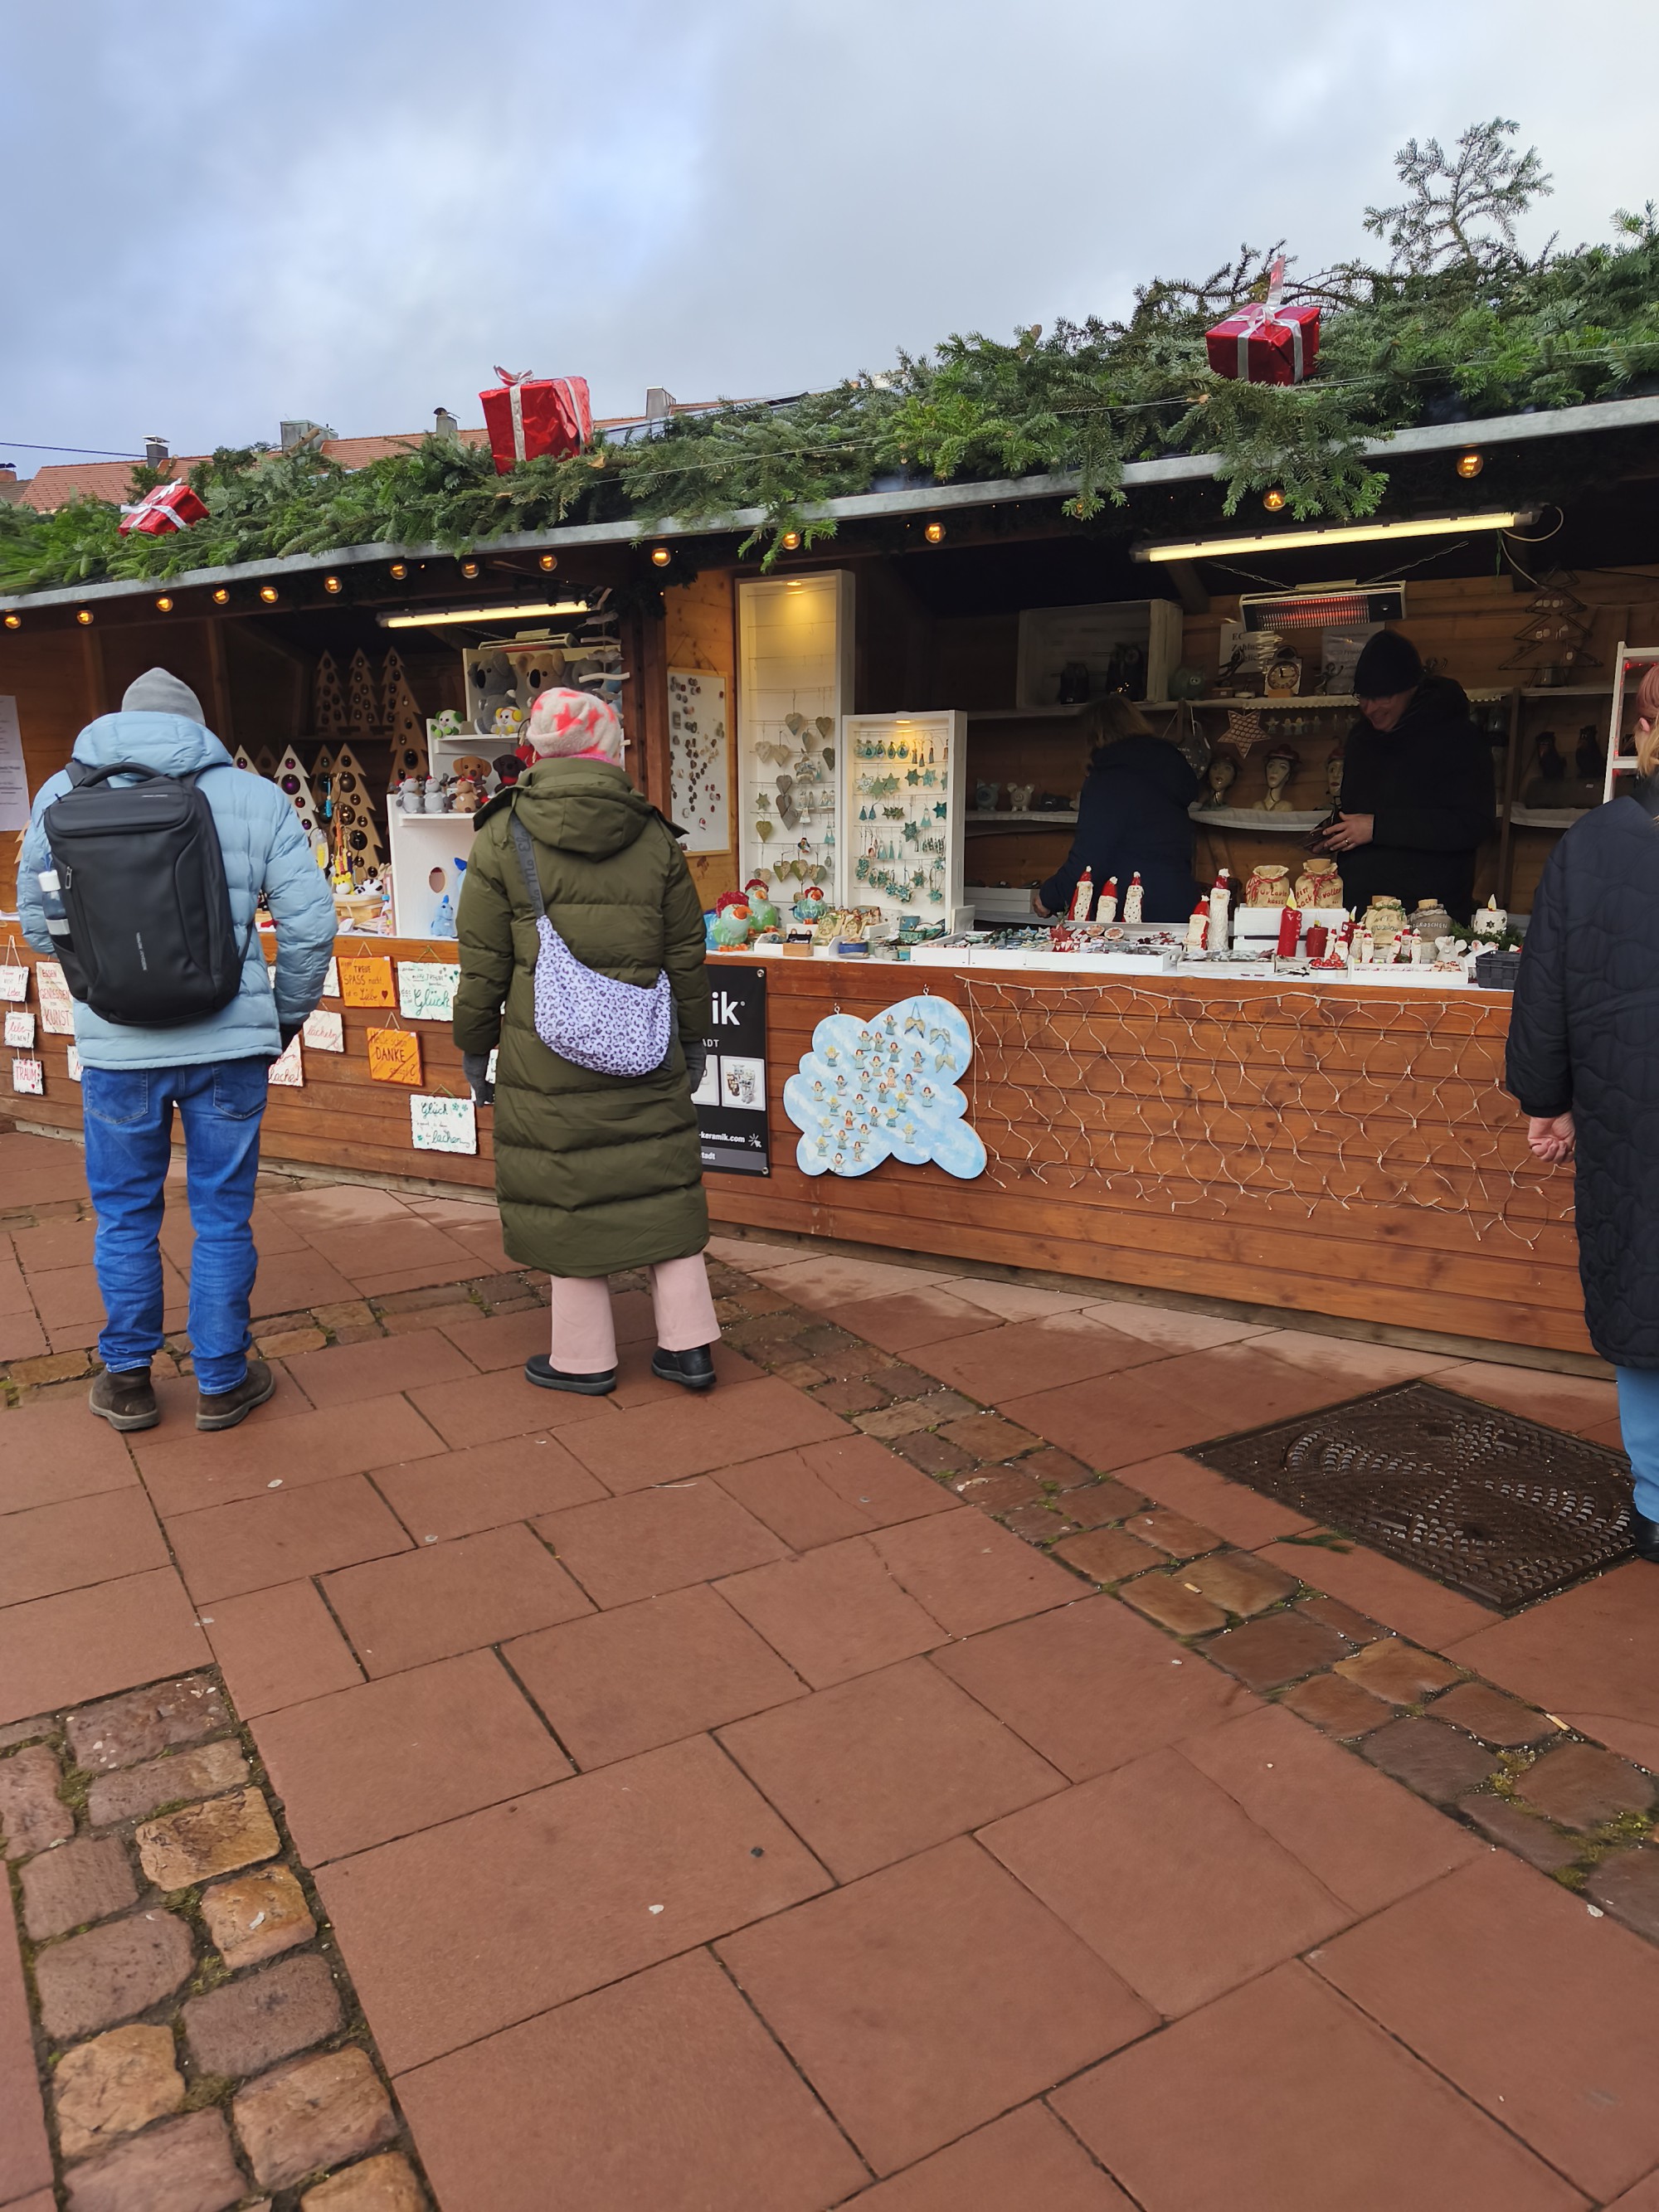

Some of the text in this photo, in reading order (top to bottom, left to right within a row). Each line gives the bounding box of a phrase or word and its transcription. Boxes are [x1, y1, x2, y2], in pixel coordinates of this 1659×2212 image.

[343, 975, 366, 985] SPASS
[414, 989, 452, 1016] Glück
[376, 1047, 406, 1062] DANKE
[421, 1101, 448, 1119] Glück
